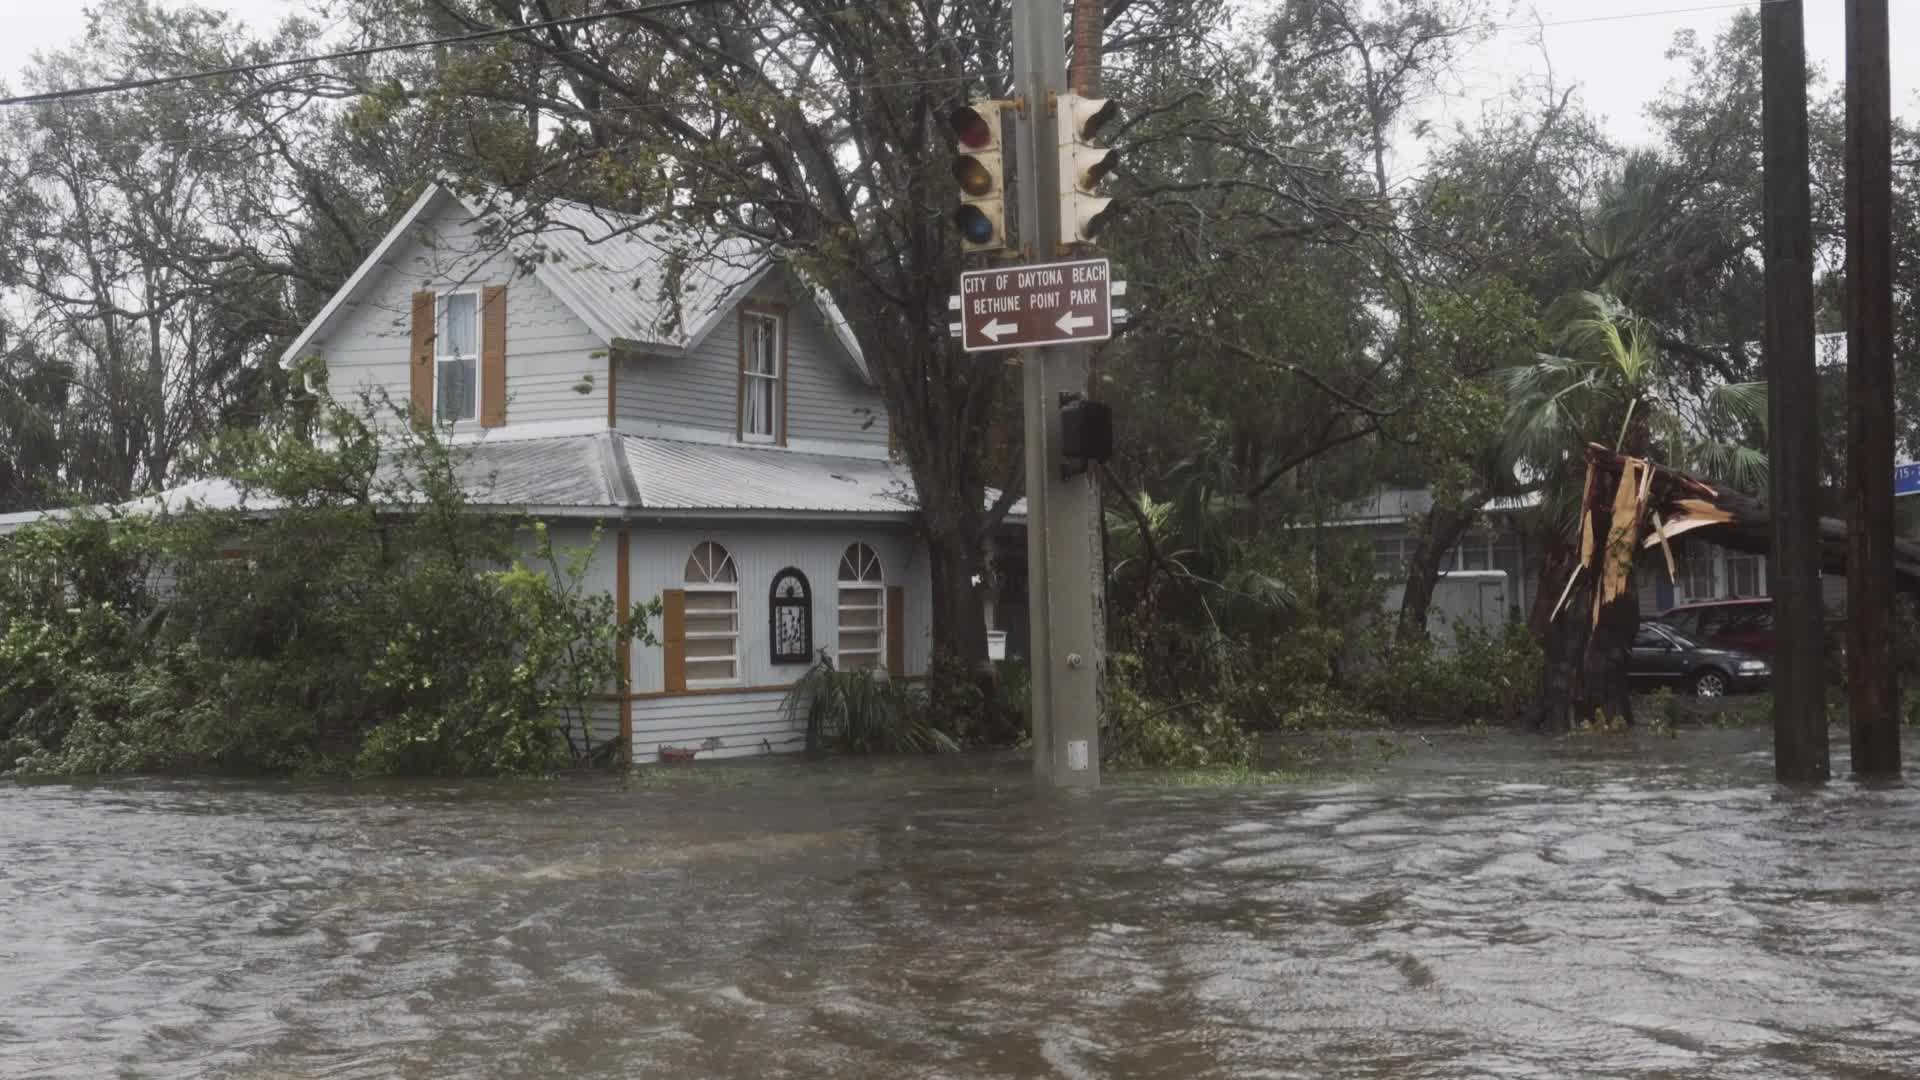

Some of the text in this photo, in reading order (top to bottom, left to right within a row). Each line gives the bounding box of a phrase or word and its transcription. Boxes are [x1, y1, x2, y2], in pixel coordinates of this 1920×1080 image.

[965, 265, 1106, 294] CITY OF DAYTONA BEACH
[974, 288, 1097, 315] BETHUNE POINT PARK
